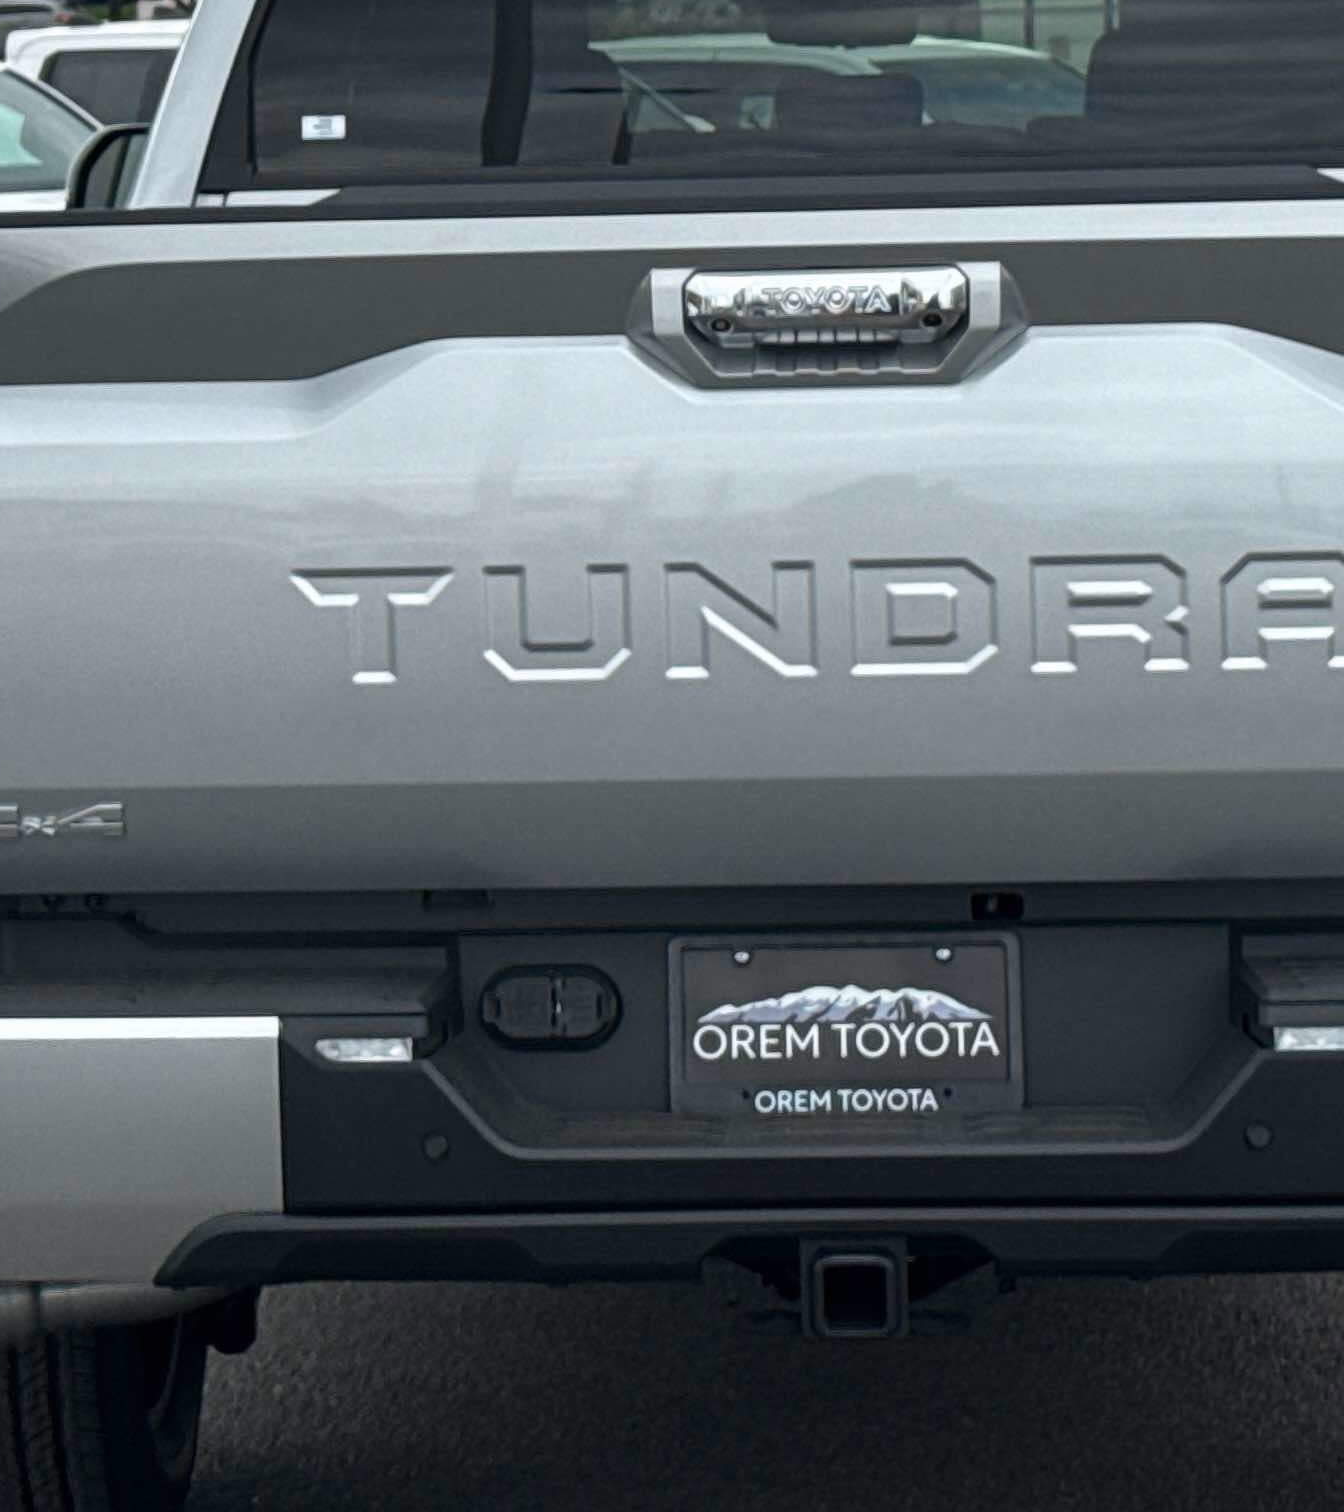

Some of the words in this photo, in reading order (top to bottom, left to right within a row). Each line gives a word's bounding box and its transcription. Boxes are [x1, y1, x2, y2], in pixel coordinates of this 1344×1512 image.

[761, 285, 893, 315] TOYOTA
[693, 1022, 821, 1060] OREM
[831, 1021, 1000, 1059] TOYOTA
[754, 1089, 832, 1114] OREM
[837, 1088, 939, 1113] TOYOTA
